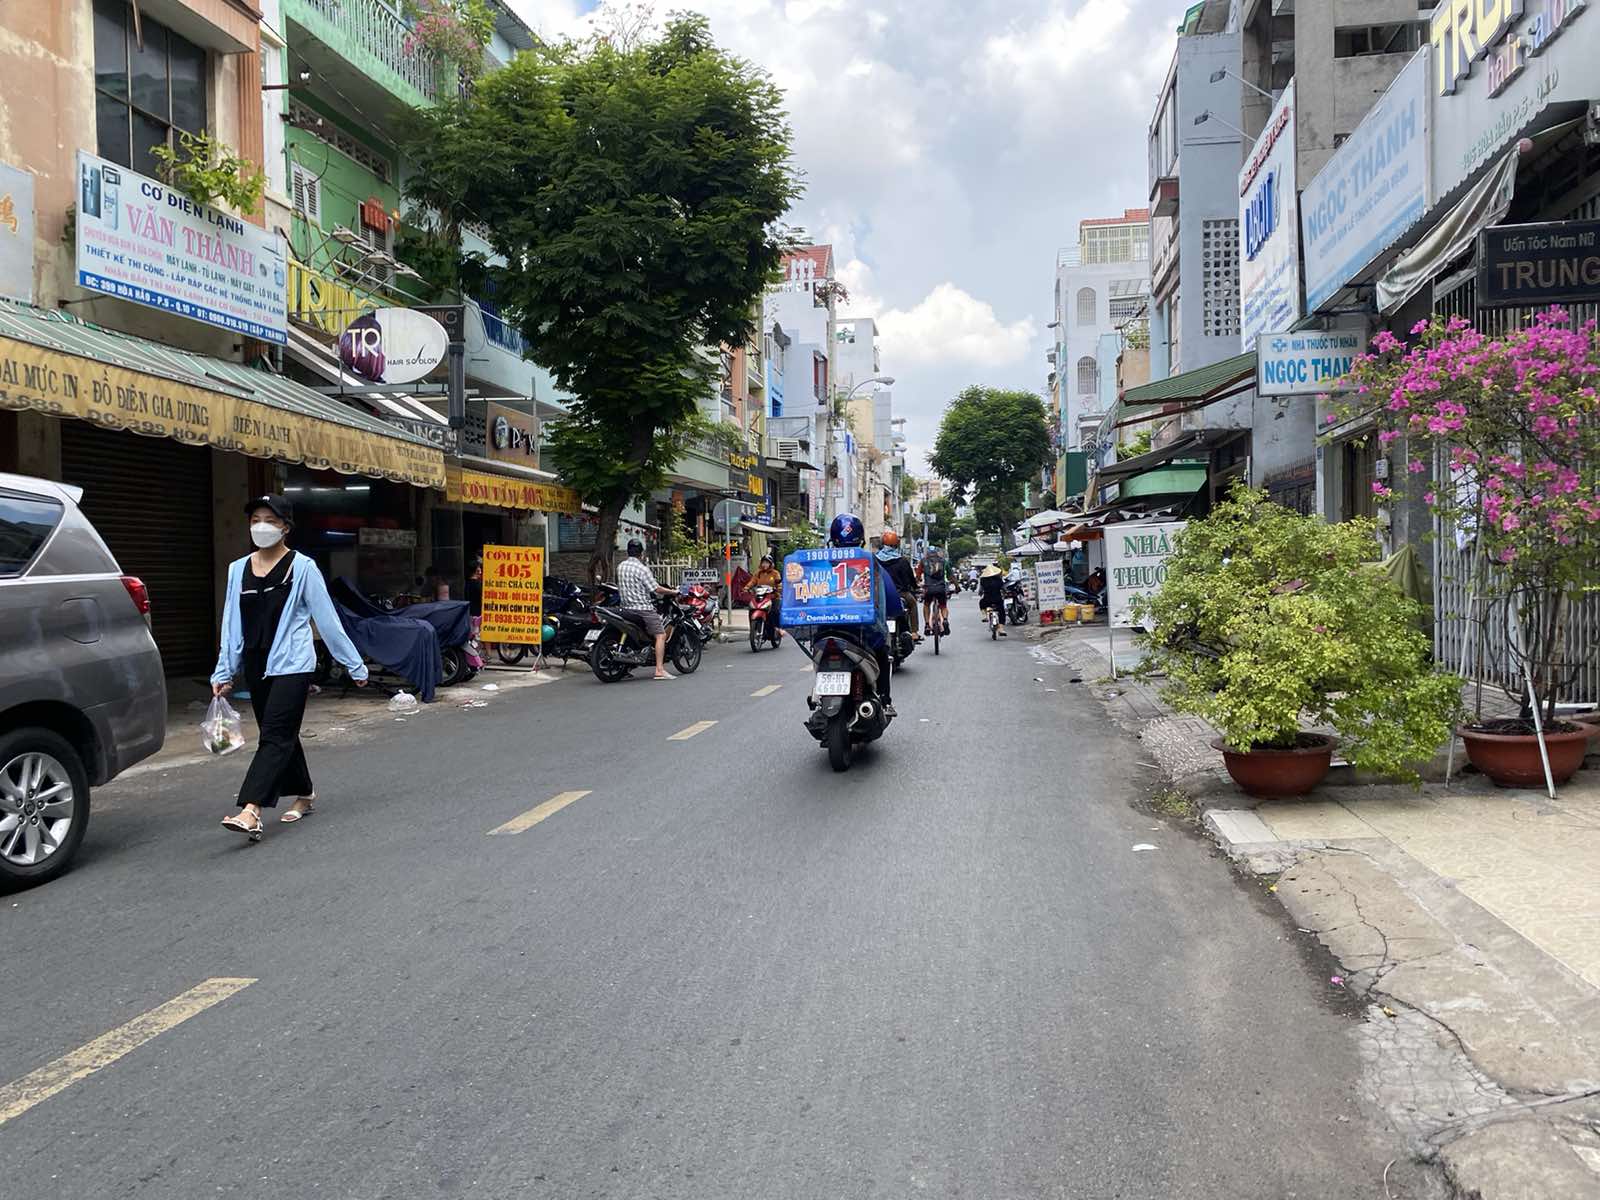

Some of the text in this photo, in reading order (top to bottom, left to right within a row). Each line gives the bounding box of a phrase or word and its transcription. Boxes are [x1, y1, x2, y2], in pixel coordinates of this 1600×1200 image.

[1432, 0, 1523, 96] TRU
[141, 182, 244, 236] CƠ ĐIỆN LẠNH
[126, 203, 255, 277] VĂN THÀNH
[1503, 231, 1596, 252] Uốn Tóc Nam Nữ
[86, 244, 110, 260] THIẾT
[113, 253, 124, 265] KẾ
[128, 258, 141, 269] THI
[143, 262, 165, 277] CÔNG
[204, 282, 217, 294] CÁC
[219, 288, 228, 300] HỆ
[231, 291, 253, 306] THỐNG
[254, 299, 267, 311] MÁY
[268, 305, 284, 316] LẠNH
[166, 253, 179, 265] MÁY
[182, 260, 197, 273] LẠNH
[202, 266, 209, 279] TỦ
[211, 272, 226, 284] LẠNH
[231, 277, 242, 288] MÁY
[1497, 257, 1600, 289] TRUNG
[100, 280, 116, 293] 399
[117, 283, 133, 298] HÒA
[135, 288, 151, 302] HẢO
[1291, 334, 1358, 351] NHÀ THUỐC TƯ NHÂN
[1264, 356, 1352, 389] NGỌC THAN
[24, 362, 58, 398] MỰC
[63, 373, 79, 400] IN
[92, 368, 112, 407] ĐỒ
[117, 383, 148, 417] ĐIỆN
[152, 395, 174, 420] GIA
[177, 399, 209, 429] DỤNG
[233, 413, 262, 440] ĐIỆN
[486, 549, 540, 562] CƠM TẤM
[807, 549, 855, 561] 1900 6099
[1123, 528, 1171, 557] NHÀ
[494, 563, 532, 578] 405
[508, 578, 523, 590] CHẢ
[525, 581, 540, 590] CUA
[810, 571, 833, 582] MUA
[832, 562, 847, 599] 1
[793, 578, 830, 603] TẶNG
[484, 601, 540, 614] MIỄN PHÍ CƠM THÊM
[807, 613, 839, 622] Domino's
